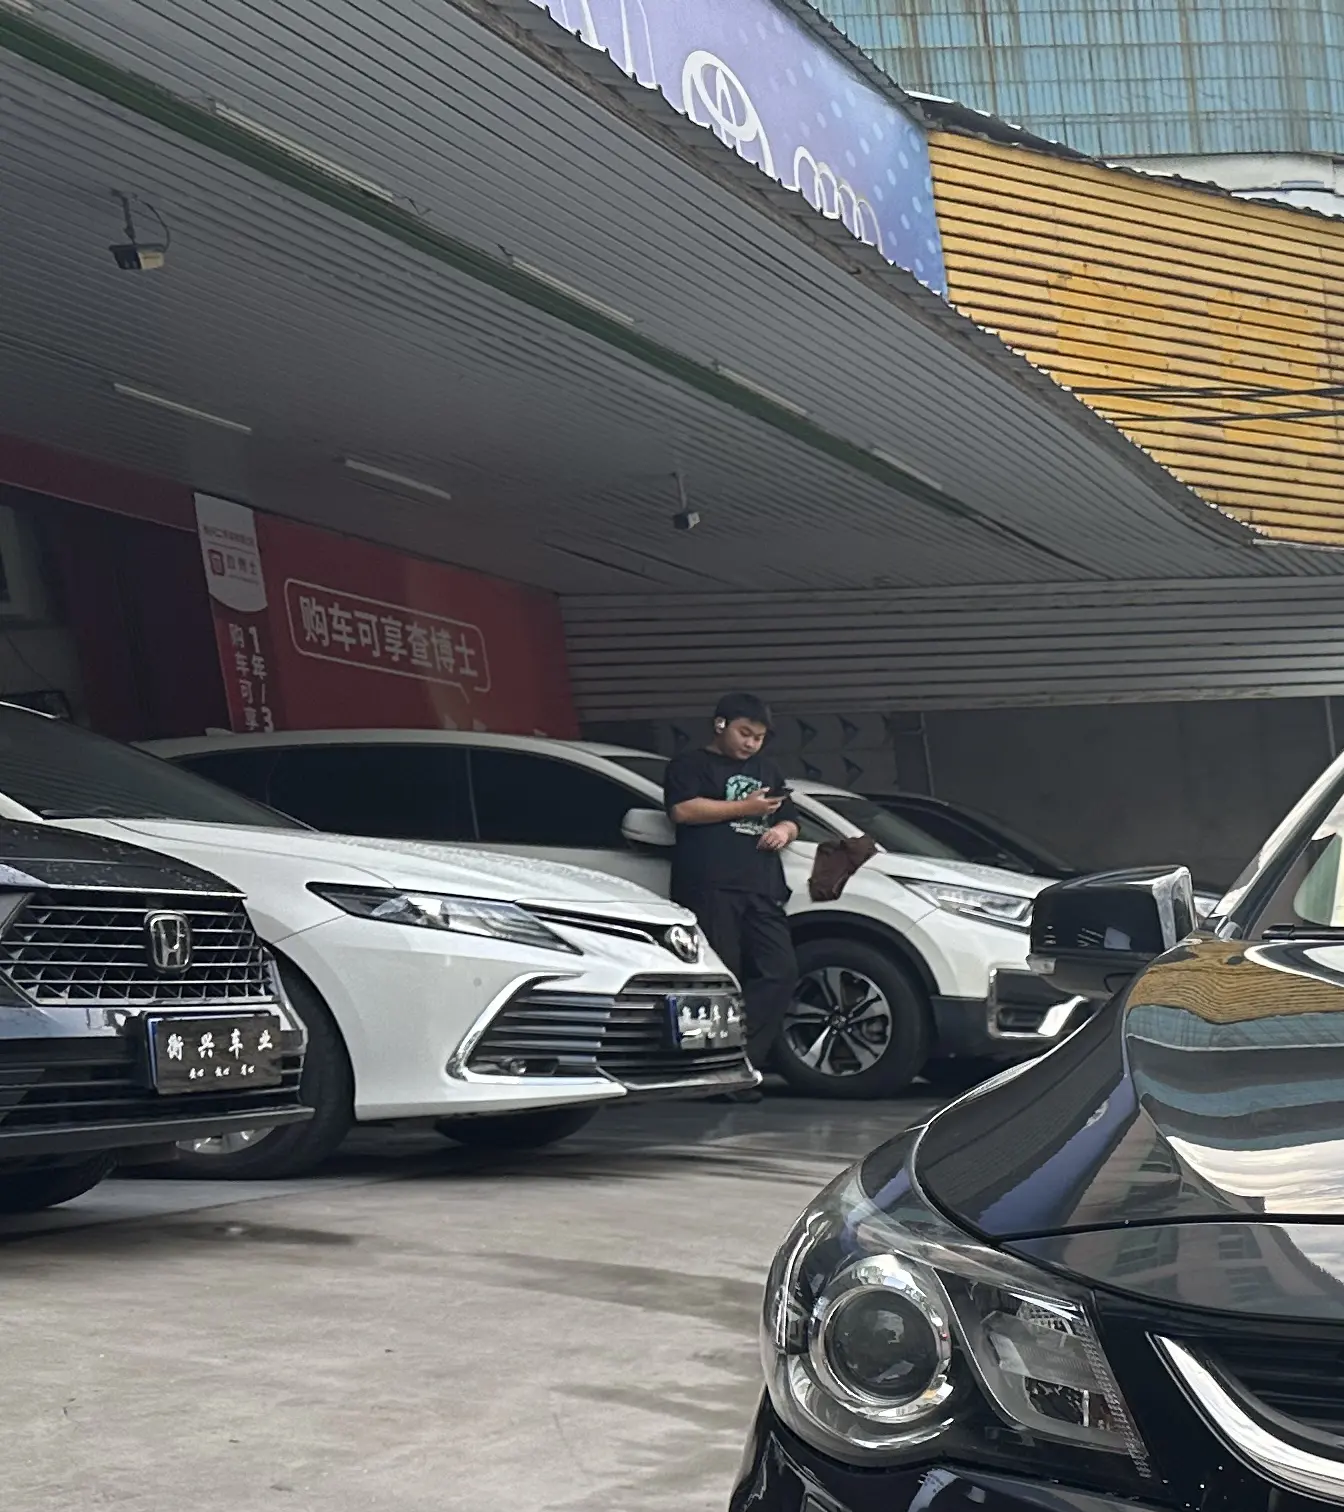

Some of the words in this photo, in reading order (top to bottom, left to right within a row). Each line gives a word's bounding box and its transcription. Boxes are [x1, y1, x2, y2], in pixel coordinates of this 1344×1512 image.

[228, 623, 260, 731] 购车可享
[299, 595, 478, 678] 购车可享查博士
